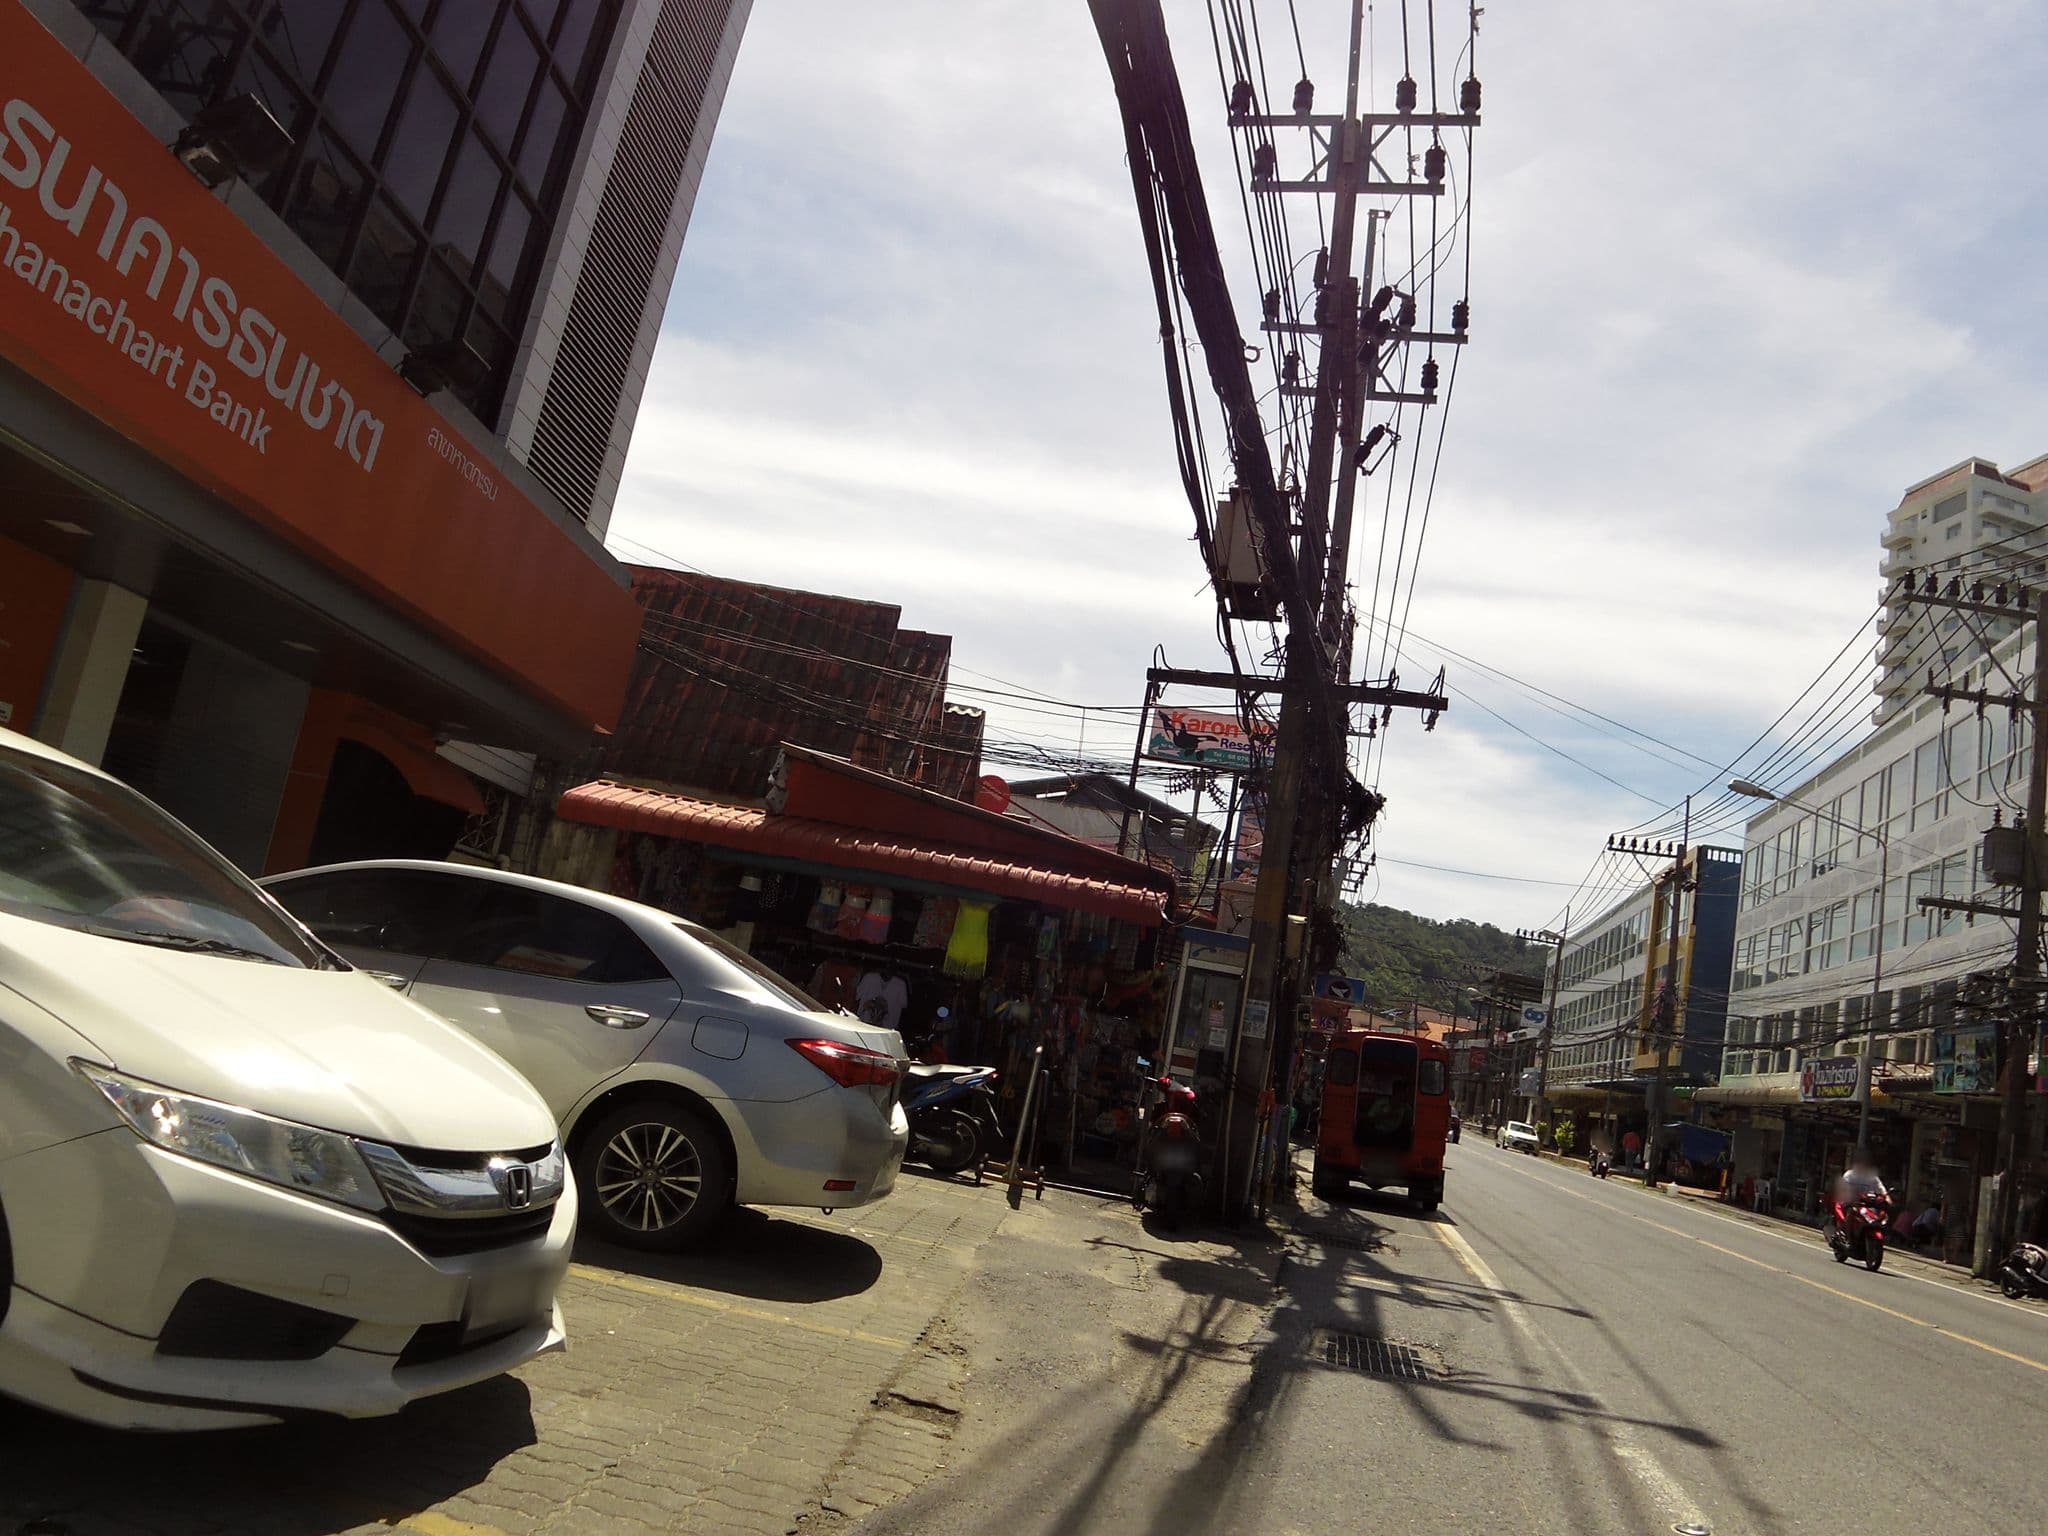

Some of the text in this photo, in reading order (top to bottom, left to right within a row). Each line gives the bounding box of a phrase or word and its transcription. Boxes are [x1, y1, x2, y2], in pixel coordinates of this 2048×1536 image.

[0, 98, 384, 473] ธนาคารธนชาต
[0, 202, 272, 454] hanachart Bank
[1171, 711, 1241, 738] Karon
